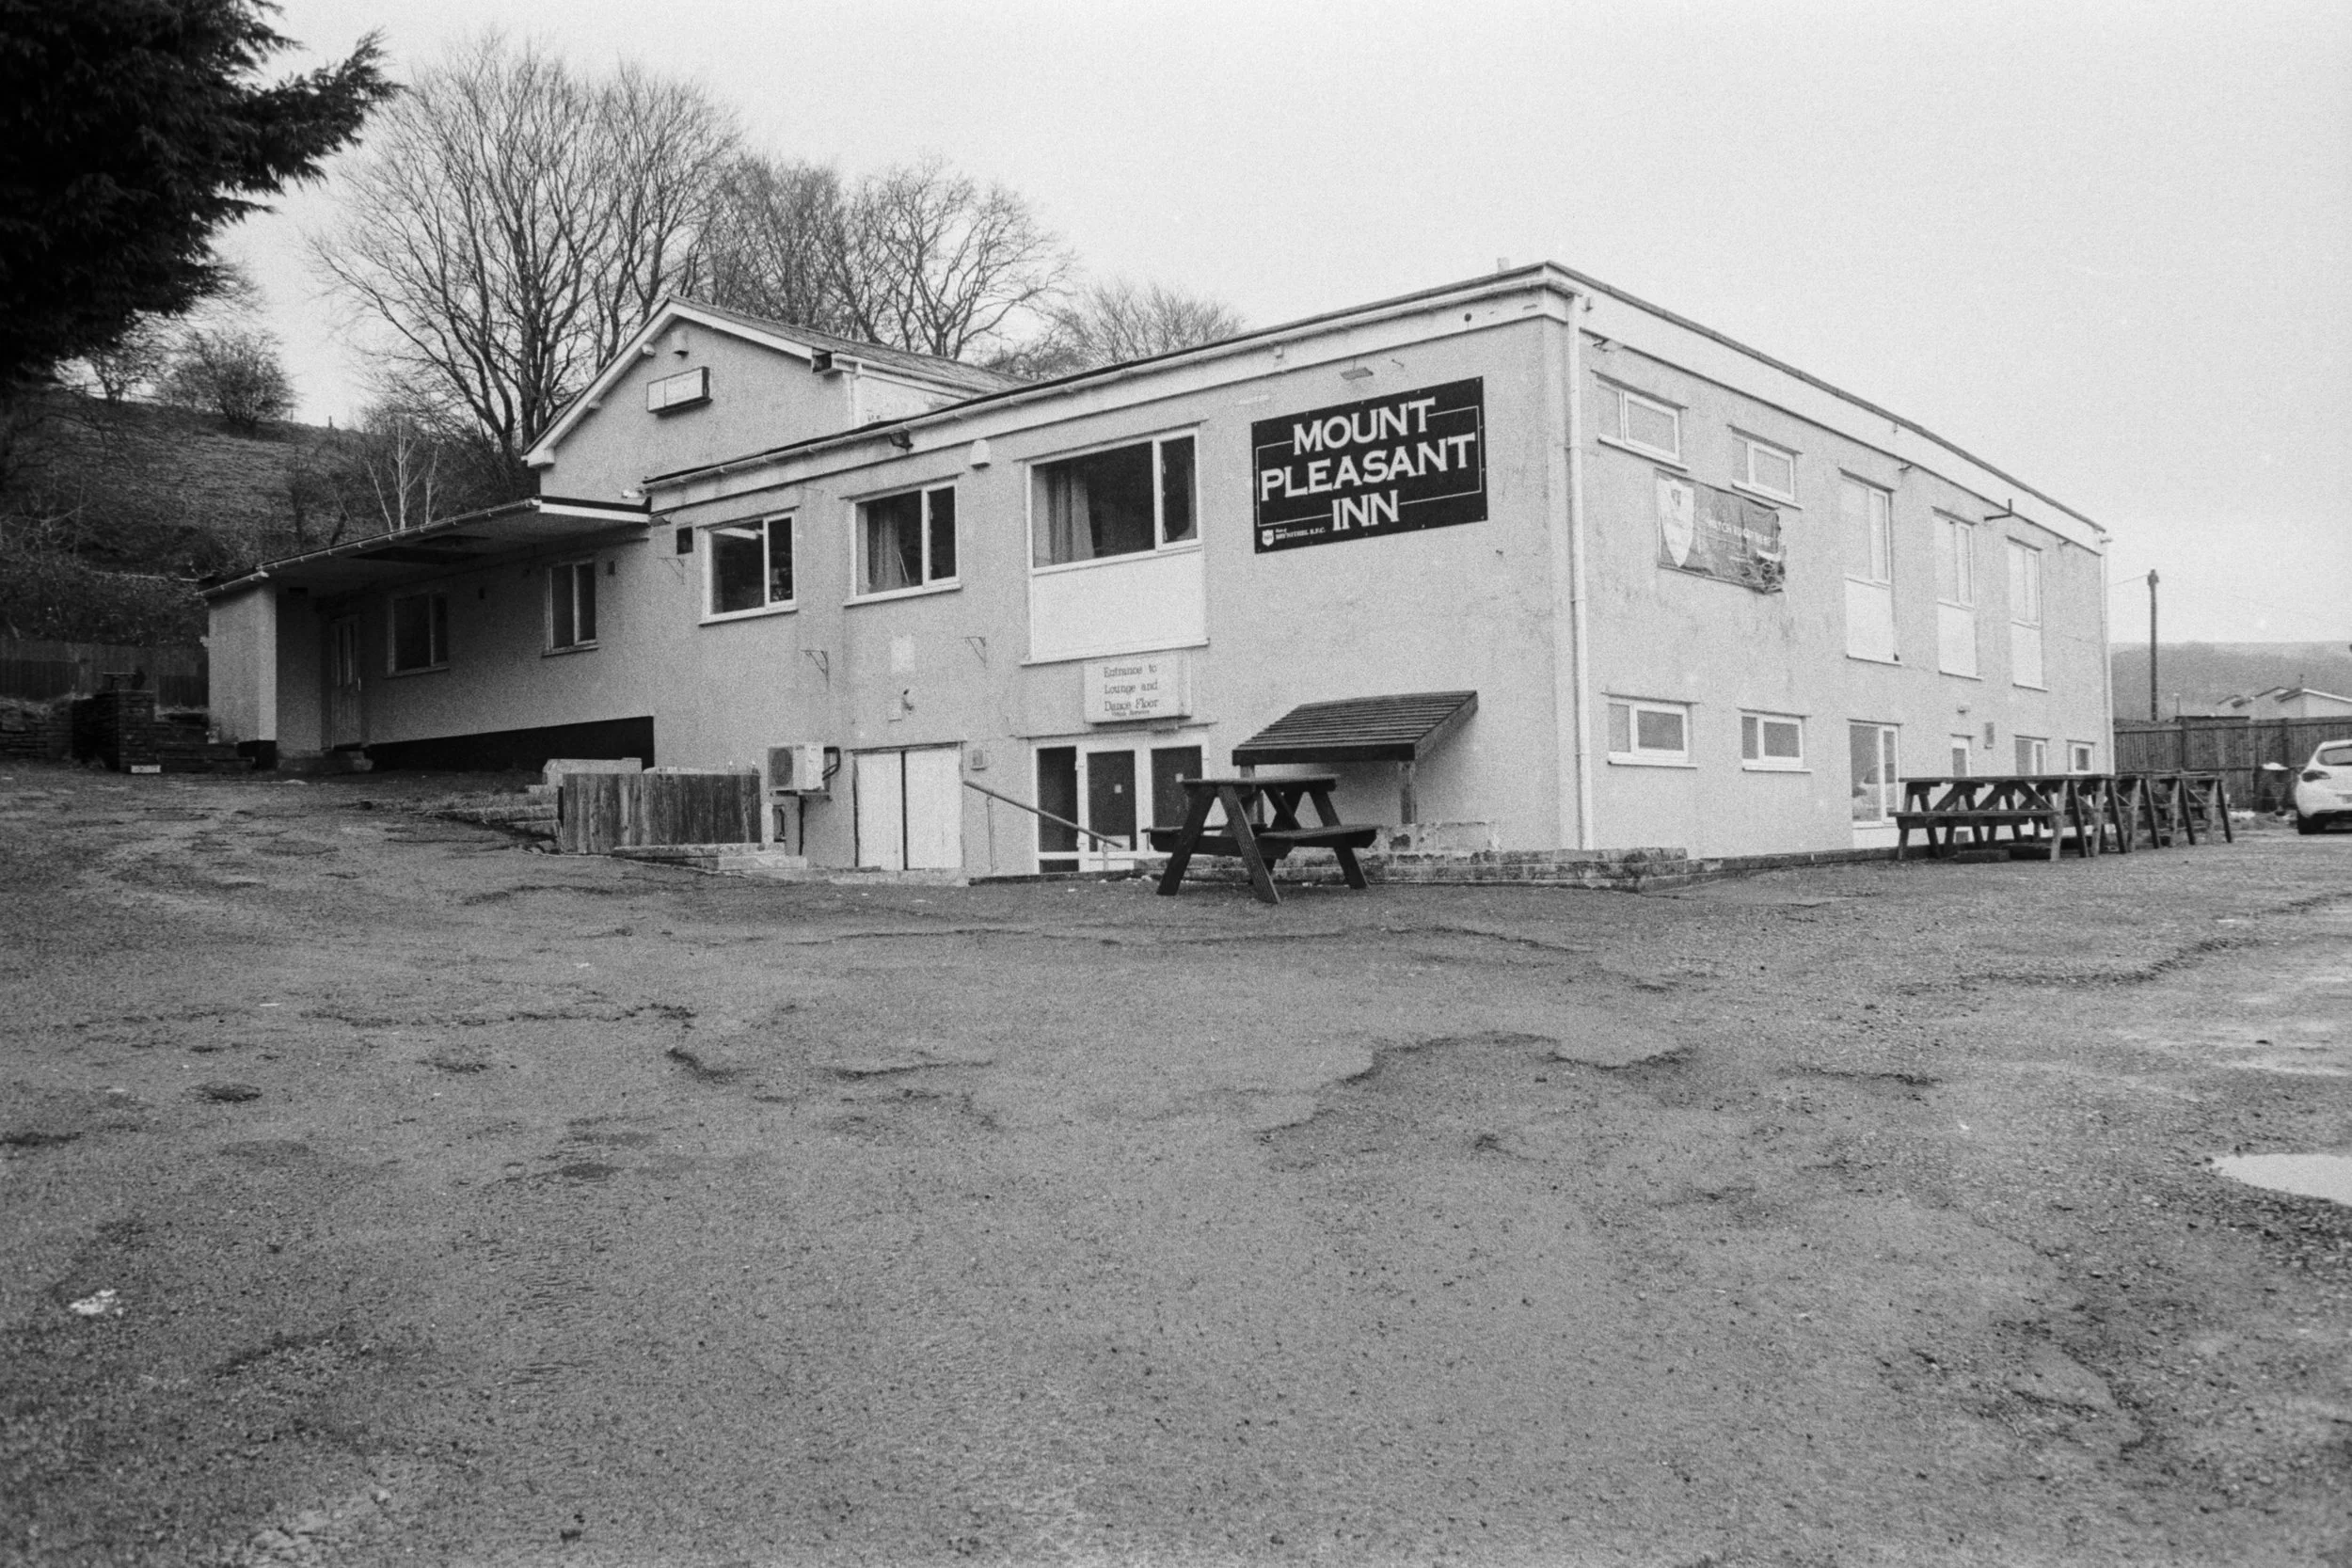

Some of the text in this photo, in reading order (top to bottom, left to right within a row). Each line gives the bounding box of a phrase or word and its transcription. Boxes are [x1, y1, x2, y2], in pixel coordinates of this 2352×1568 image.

[1293, 396, 1436, 456] MOUNT
[1260, 432, 1476, 501] PLEASANT
[1331, 489, 1400, 531] INN
[1104, 664, 1157, 677] Entrance to
[1104, 679, 1158, 694] Lounge and
[1104, 698, 1159, 712] Dance Floor
